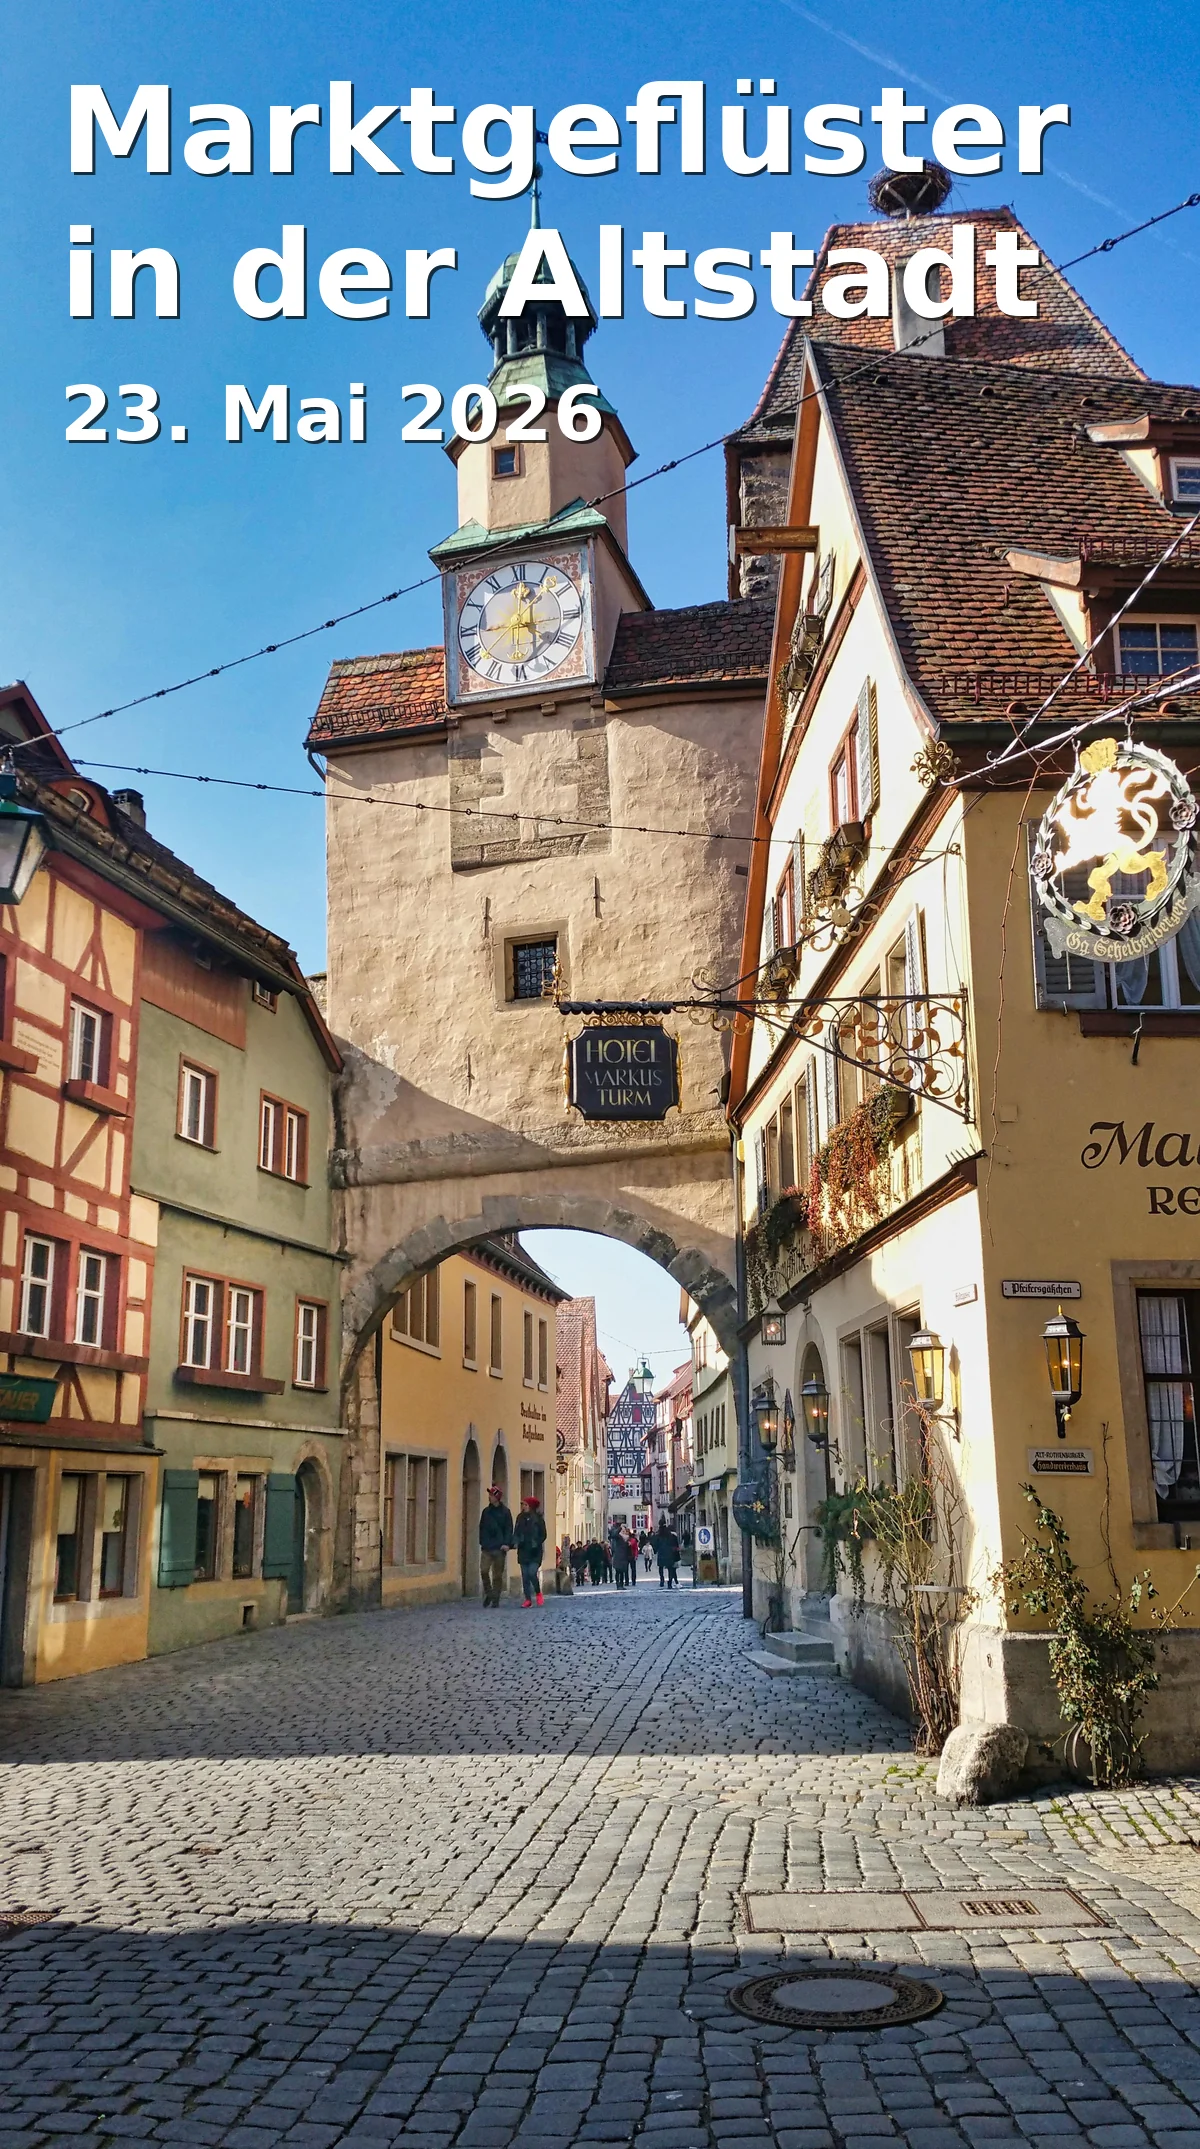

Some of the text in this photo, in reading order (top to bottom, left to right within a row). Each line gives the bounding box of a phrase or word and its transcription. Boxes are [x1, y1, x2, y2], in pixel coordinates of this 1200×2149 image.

[586, 1039, 661, 1063] HOTEL
[585, 1069, 663, 1086] MARKUS
[597, 1089, 652, 1106] TURM
[1081, 1120, 1200, 1169] Ma
